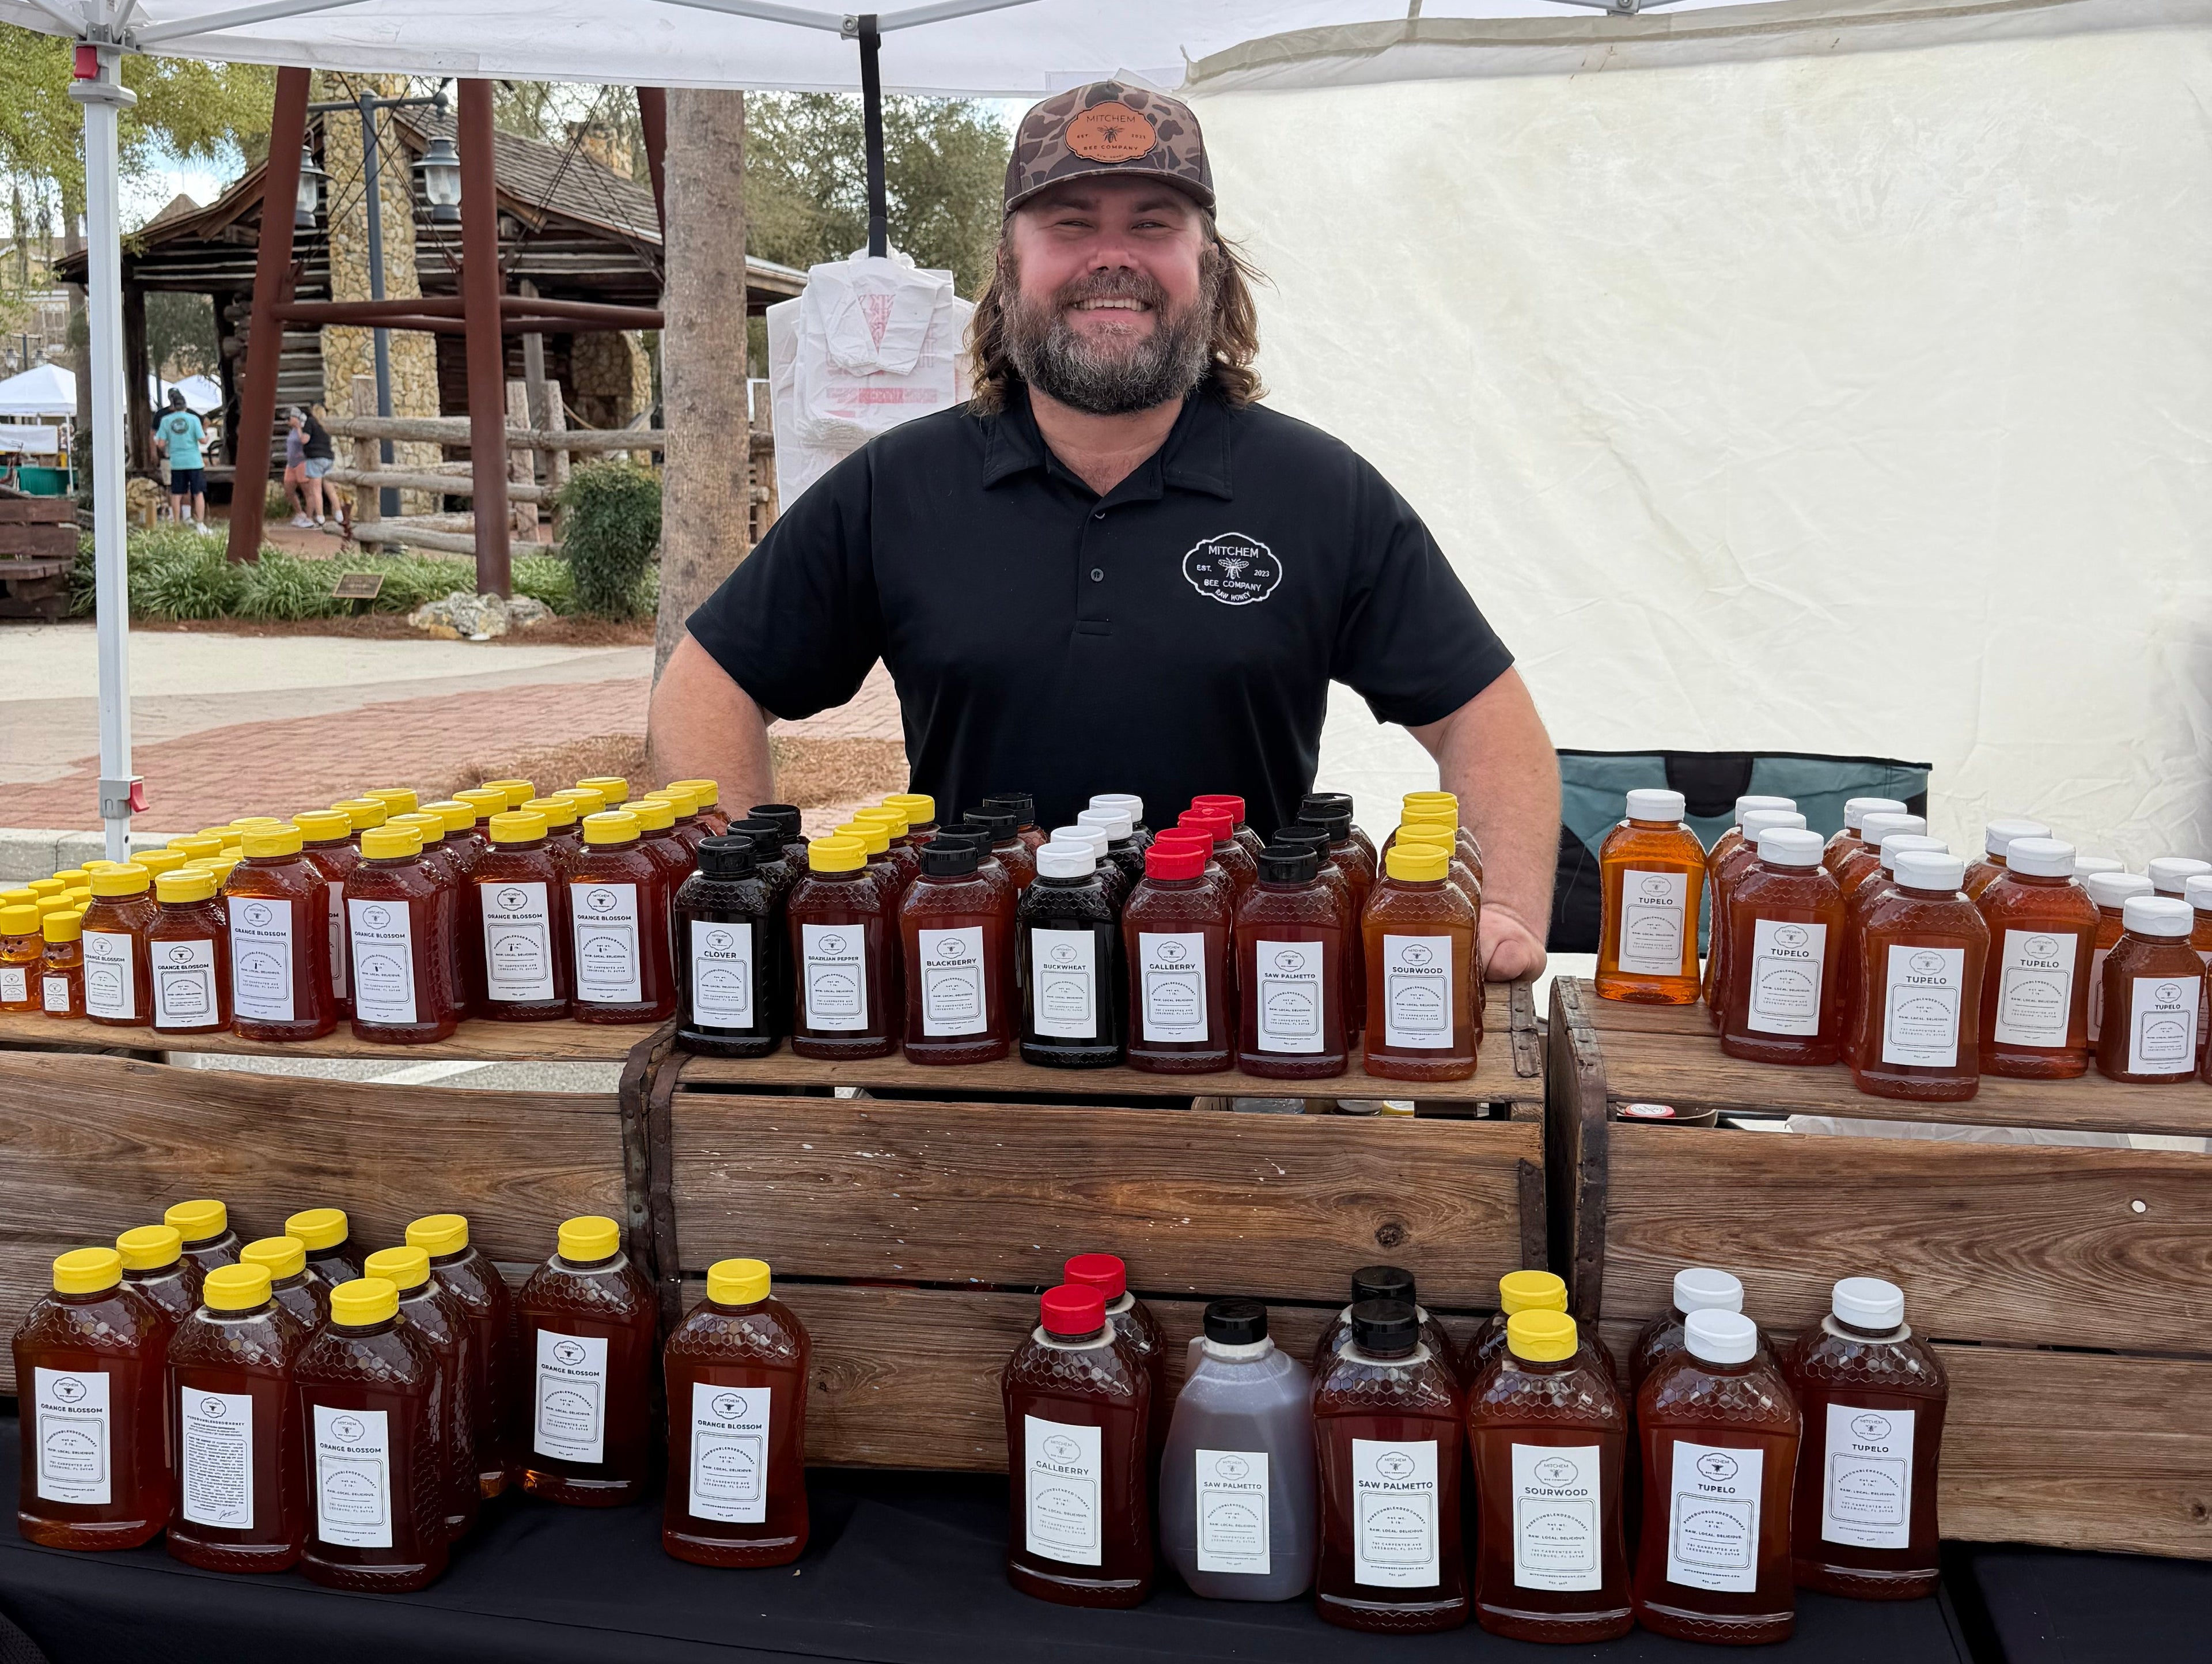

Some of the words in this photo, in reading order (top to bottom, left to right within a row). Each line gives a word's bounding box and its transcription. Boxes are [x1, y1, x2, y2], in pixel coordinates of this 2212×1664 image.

[1086, 115, 1135, 123] MITCHEM
[1209, 546, 1259, 558] MITCHEM
[1223, 581, 1262, 591] COMPANY
[1215, 589, 1228, 599] RAW
[1231, 591, 1251, 601] HONEY
[1639, 897, 1673, 905] TUPELO
[704, 951, 736, 959] CLOVER
[1771, 948, 1809, 957] TUPELO
[926, 958, 977, 966] BLACKBERRY
[2020, 959, 2059, 968] TUPELO
[1906, 976, 1947, 985] TUPELO
[541, 1364, 566, 1373] ORANGE
[41, 1404, 66, 1412] ORANGE
[698, 1420, 725, 1428] ORANGE
[320, 1443, 345, 1452] ORANGE
[1852, 1444, 1889, 1453] TUPELO
[1036, 1460, 1089, 1475] GALLBERRY
[1384, 1481, 1433, 1489] PALMETTO
[1698, 1484, 1736, 1493] TUPELO
[1525, 1487, 1588, 1496] SOURWOOD
